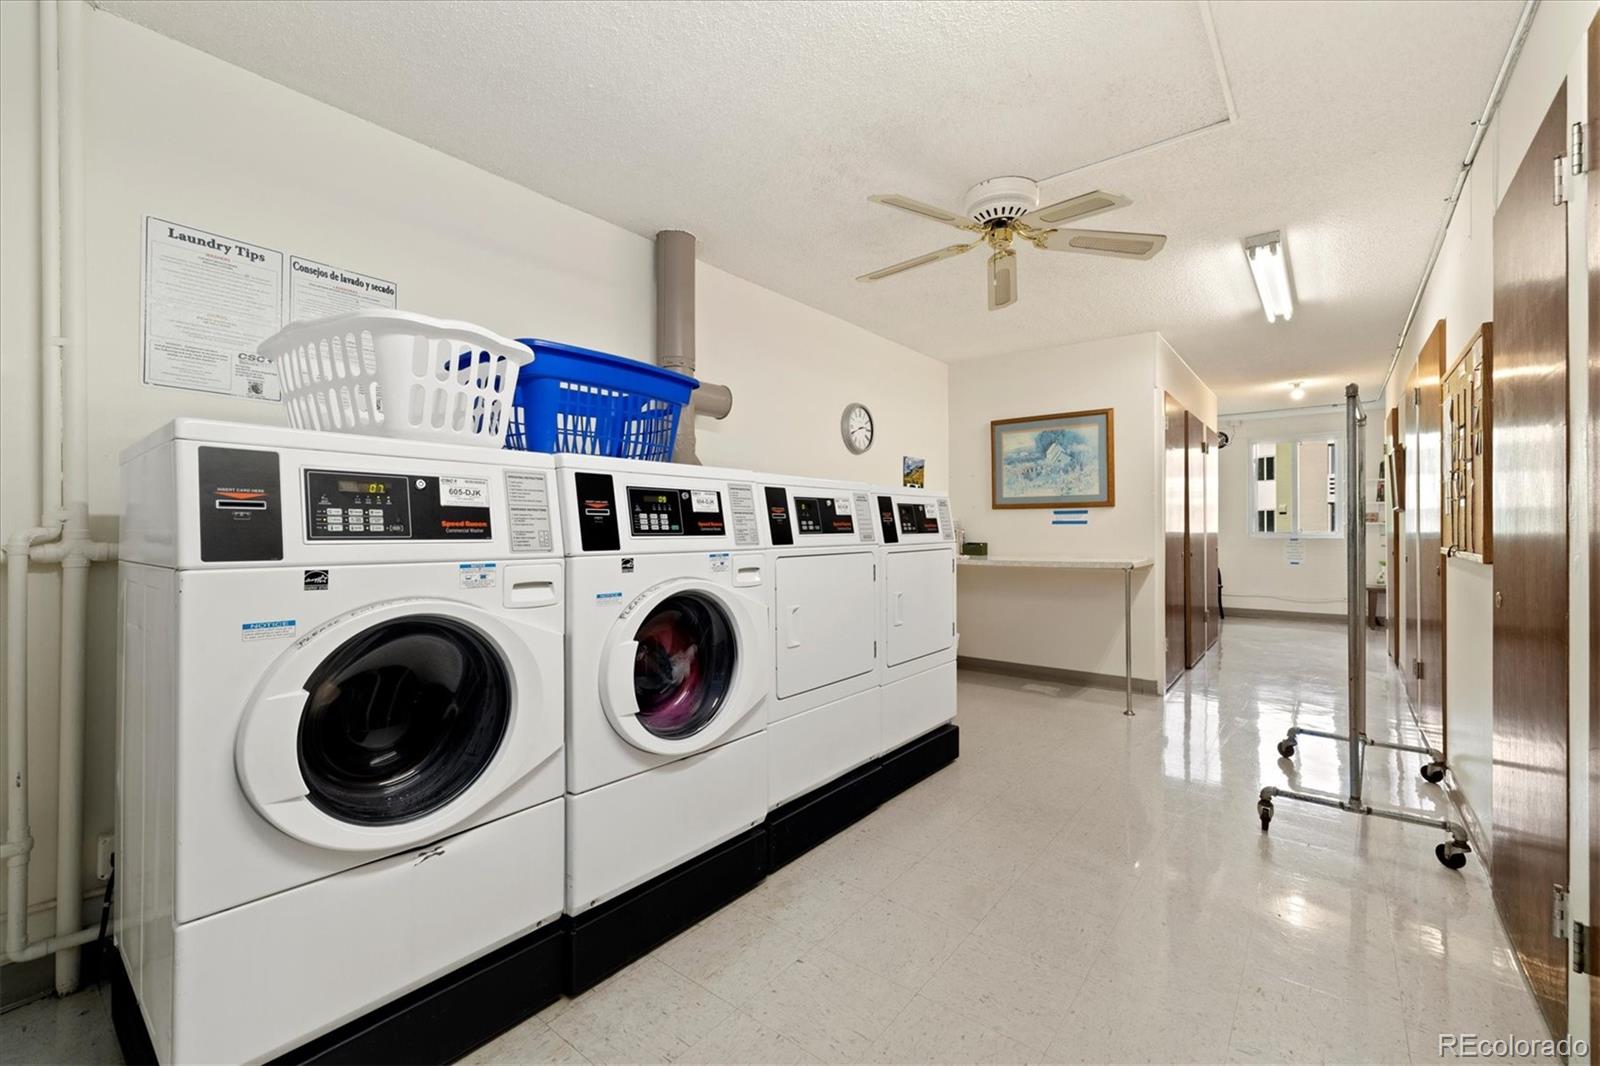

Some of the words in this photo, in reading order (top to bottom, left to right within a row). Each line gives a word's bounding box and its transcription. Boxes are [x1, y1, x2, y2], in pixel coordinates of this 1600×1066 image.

[168, 227, 233, 256] Laundry
[235, 244, 266, 263] Tips
[293, 261, 328, 279] Consejos
[329, 271, 340, 282] de
[340, 273, 365, 288] lavado
[365, 282, 371, 291] y
[371, 283, 395, 296] secado
[448, 488, 482, 496] 605-DJK
[249, 621, 290, 631] NOTICE
